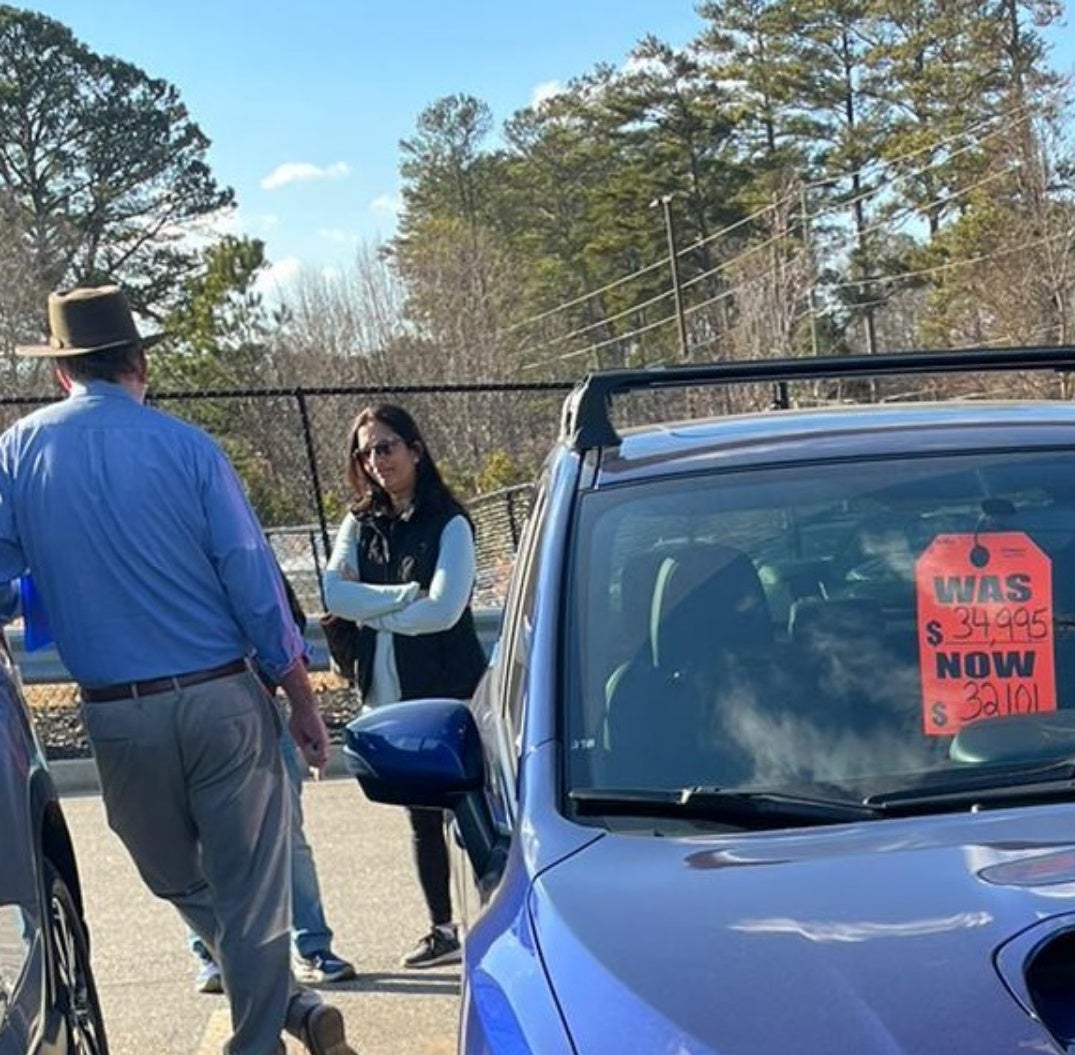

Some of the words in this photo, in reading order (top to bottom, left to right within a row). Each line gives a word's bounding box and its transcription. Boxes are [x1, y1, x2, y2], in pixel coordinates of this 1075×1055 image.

[934, 573, 1032, 604] WAS
[926, 620, 943, 646] $
[953, 607, 1048, 646] 34,995
[936, 651, 1036, 679] NOW
[931, 702, 947, 727] $
